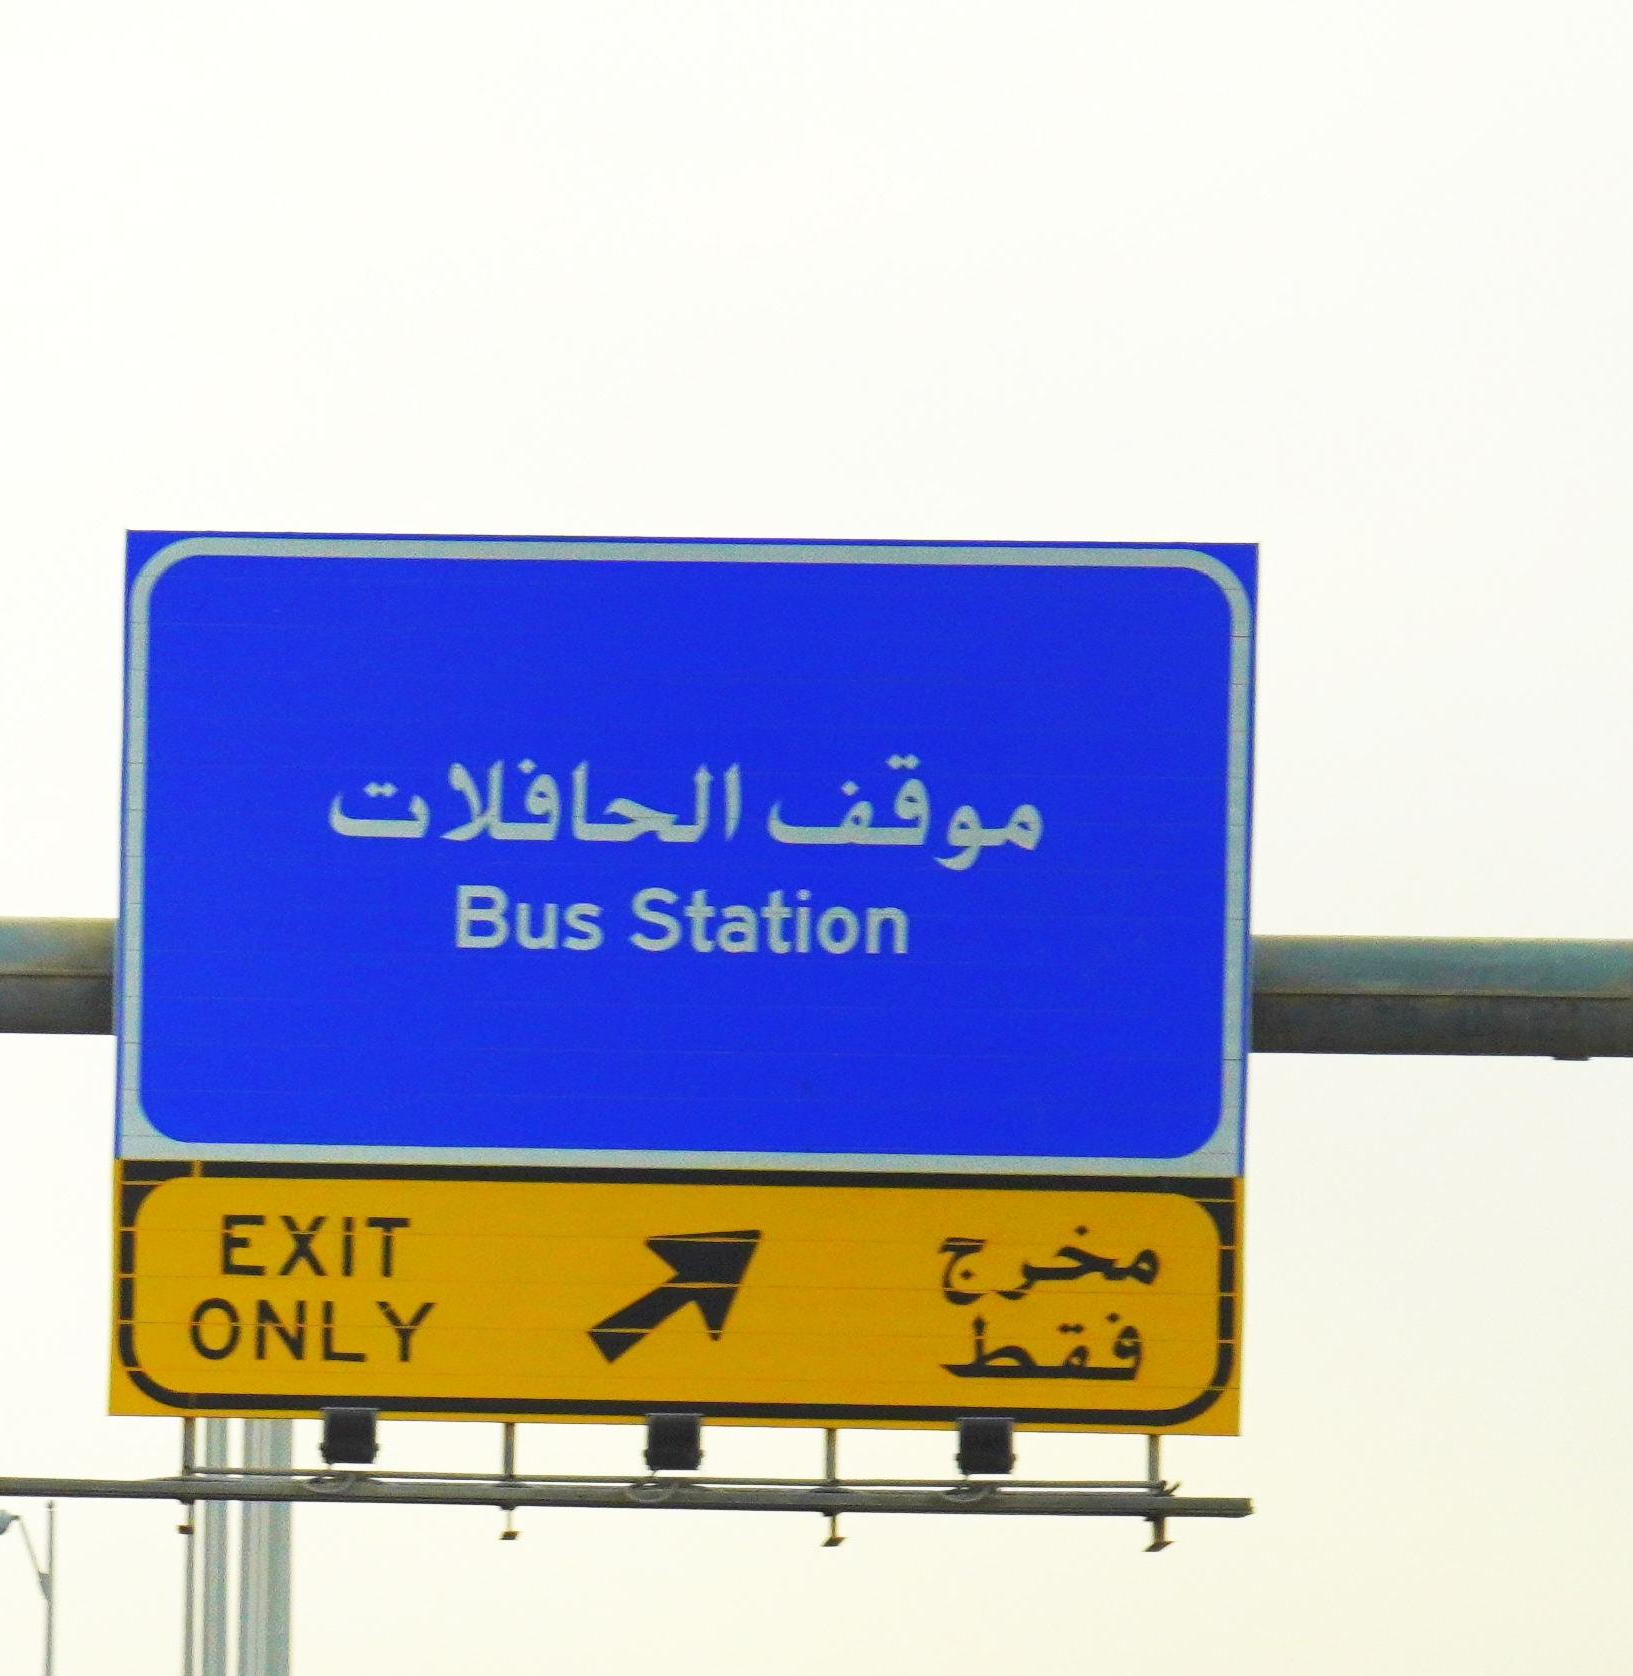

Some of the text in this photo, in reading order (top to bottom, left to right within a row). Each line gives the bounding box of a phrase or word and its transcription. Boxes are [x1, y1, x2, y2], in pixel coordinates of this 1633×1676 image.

[328, 754, 1043, 871] موقف الحافلات
[455, 884, 909, 955] Bus Station
[221, 1213, 411, 1279] EXIT
[938, 1224, 1161, 1306] مخرج
[188, 1297, 436, 1363] ONLY
[940, 1311, 1144, 1381] فقط
